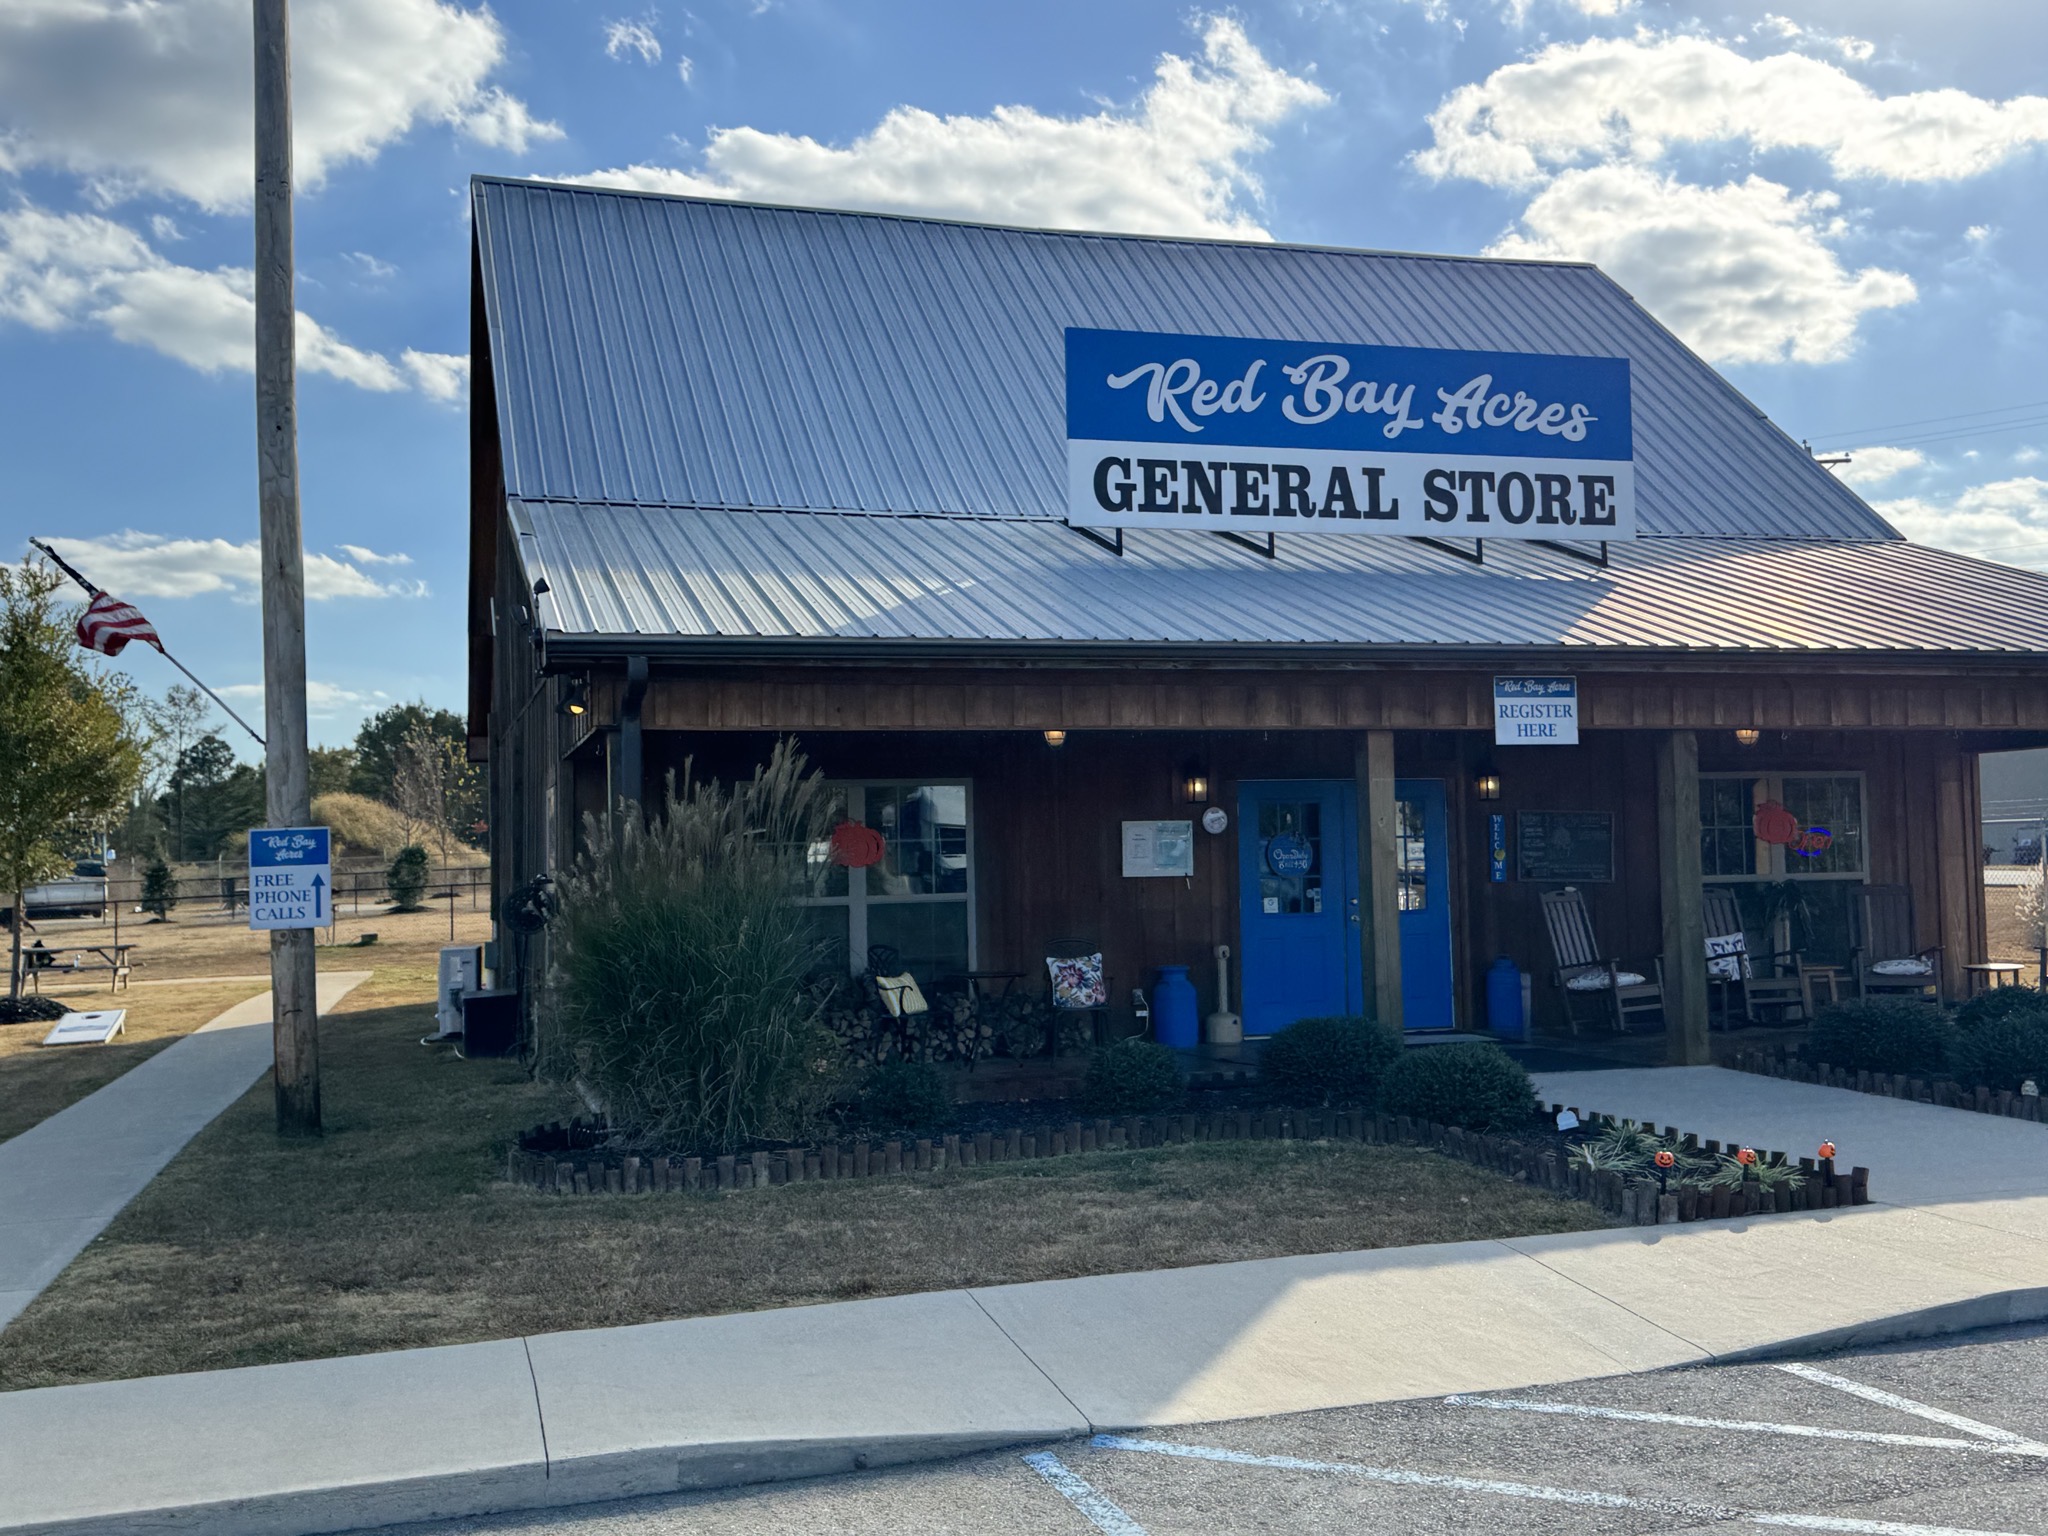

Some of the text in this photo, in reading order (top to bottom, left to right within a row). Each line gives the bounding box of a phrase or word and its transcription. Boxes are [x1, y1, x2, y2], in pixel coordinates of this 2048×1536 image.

[1107, 354, 1599, 442] Red Bay Acres
[1093, 456, 1617, 526] GENERAL STORE
[1499, 680, 1571, 695] Red Bay Acres
[1498, 704, 1573, 718] REGISTER
[1516, 723, 1557, 737] HERE
[262, 834, 317, 850] Red Bay
[275, 848, 304, 861] Acres
[255, 874, 294, 887] FREE
[255, 890, 311, 904] PHONE
[255, 906, 306, 921] CALLS
